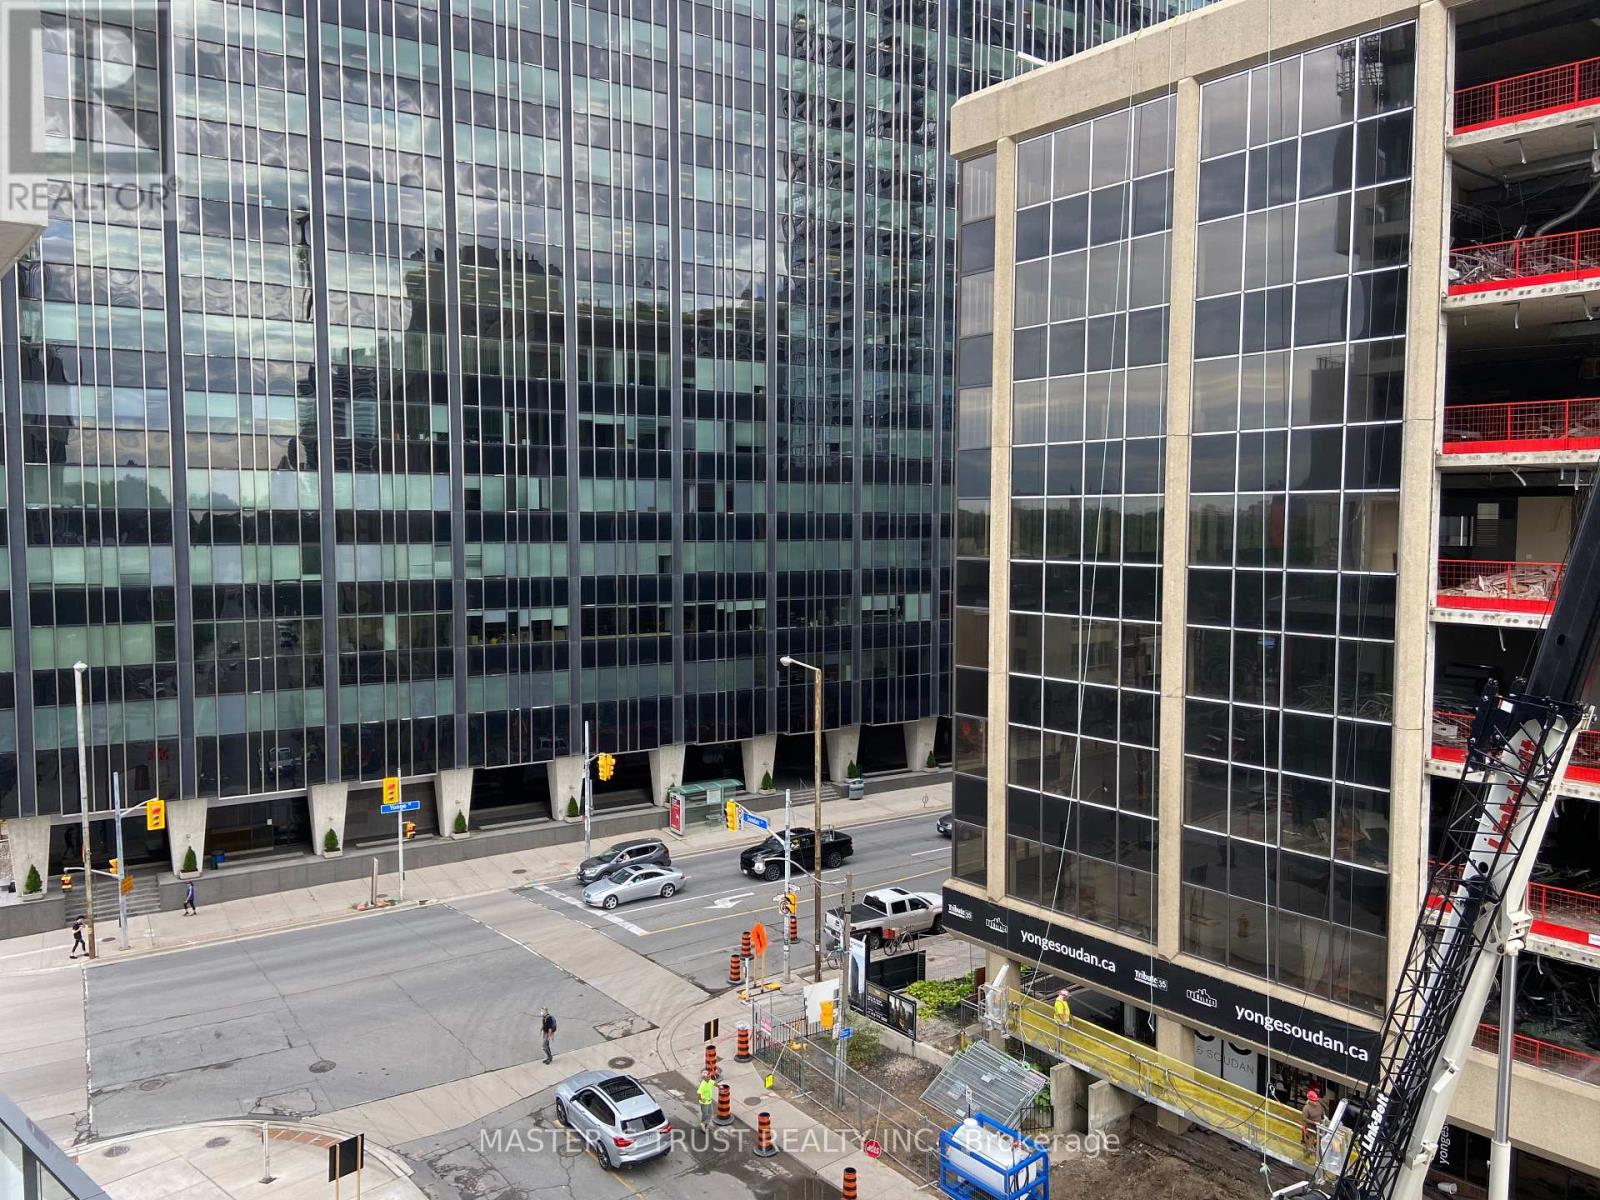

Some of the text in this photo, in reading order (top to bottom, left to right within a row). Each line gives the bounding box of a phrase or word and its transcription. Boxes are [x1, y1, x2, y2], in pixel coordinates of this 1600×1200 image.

[1020, 929, 1117, 973] yongesoudan.ca
[1134, 970, 1158, 984] Tribute
[1235, 1005, 1370, 1062] yongesoudan.ca
[1207, 1049, 1255, 1075] SOUDAN
[1361, 1092, 1390, 1153] Link-Belt
